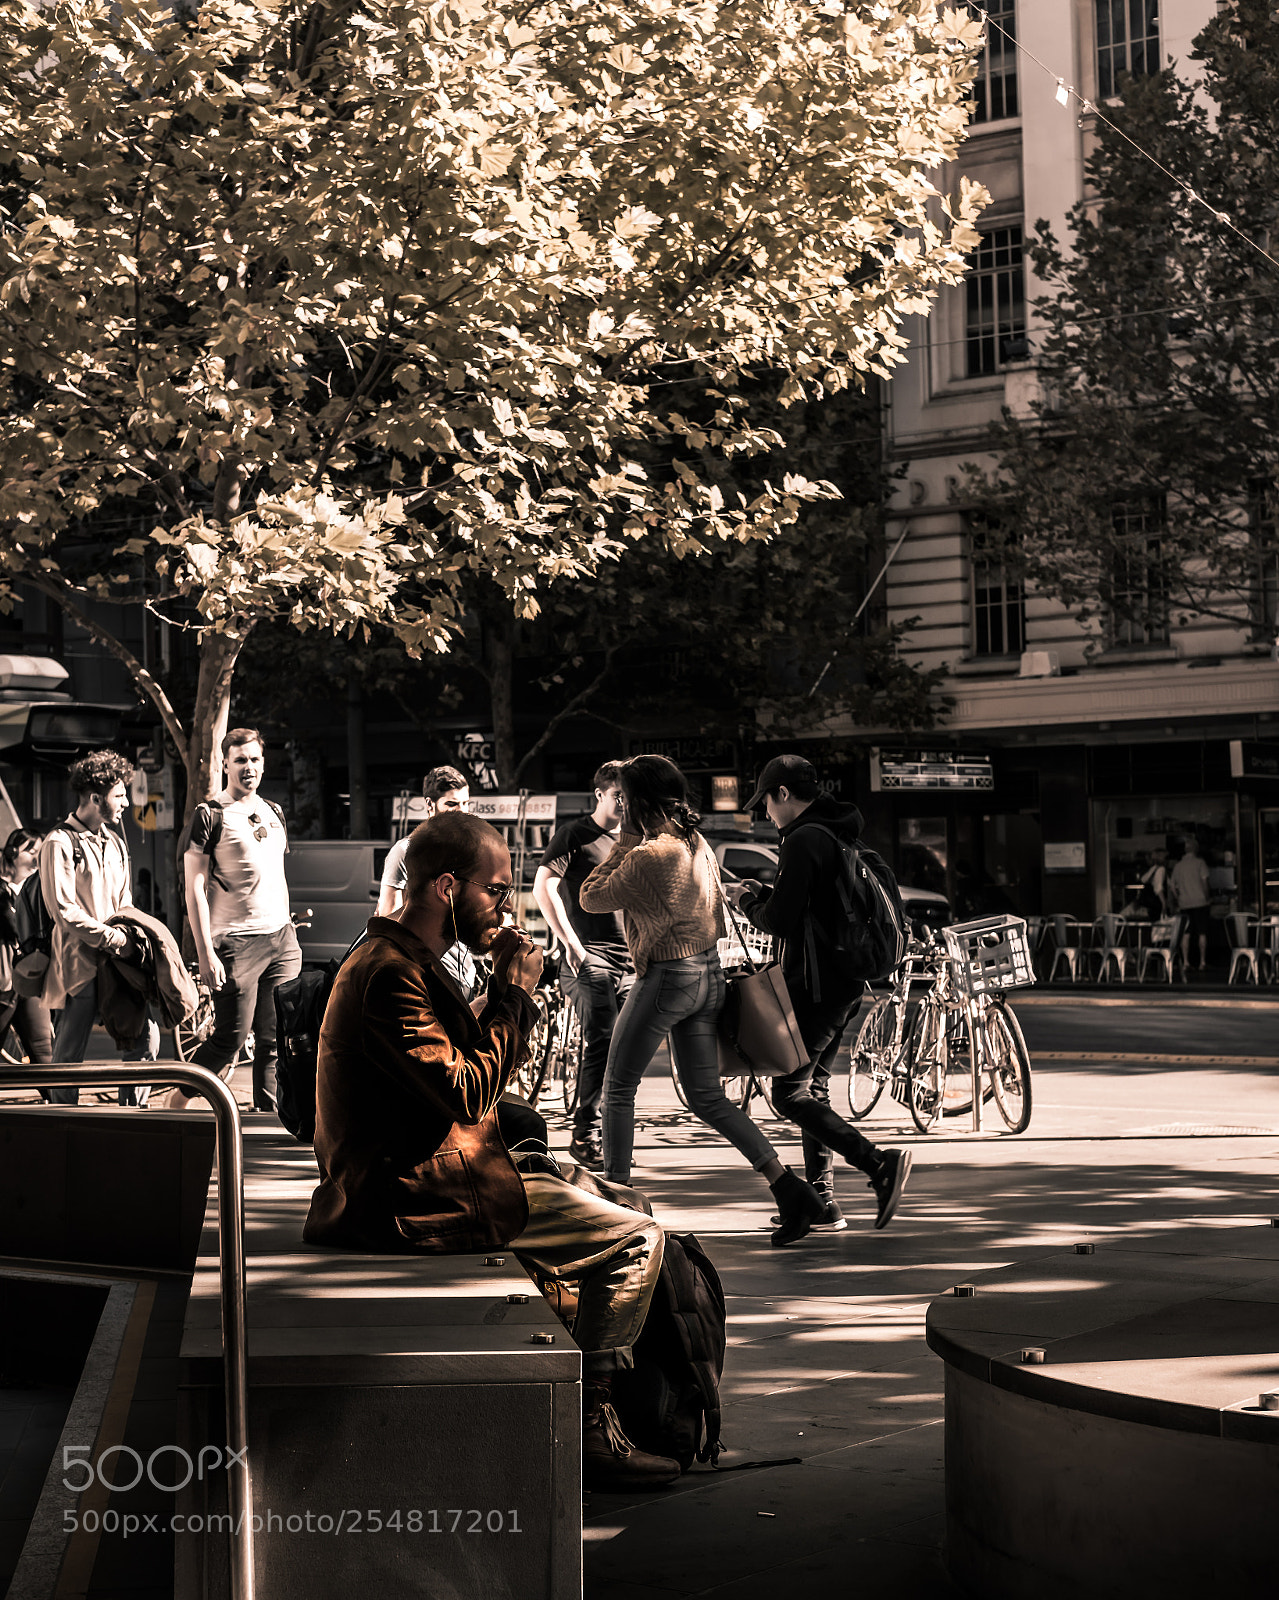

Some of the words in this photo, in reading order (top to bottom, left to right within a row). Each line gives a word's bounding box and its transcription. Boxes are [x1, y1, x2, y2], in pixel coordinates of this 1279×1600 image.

[458, 743, 491, 760] KFC
[817, 779, 842, 793] 401
[468, 801, 496, 814] Glass
